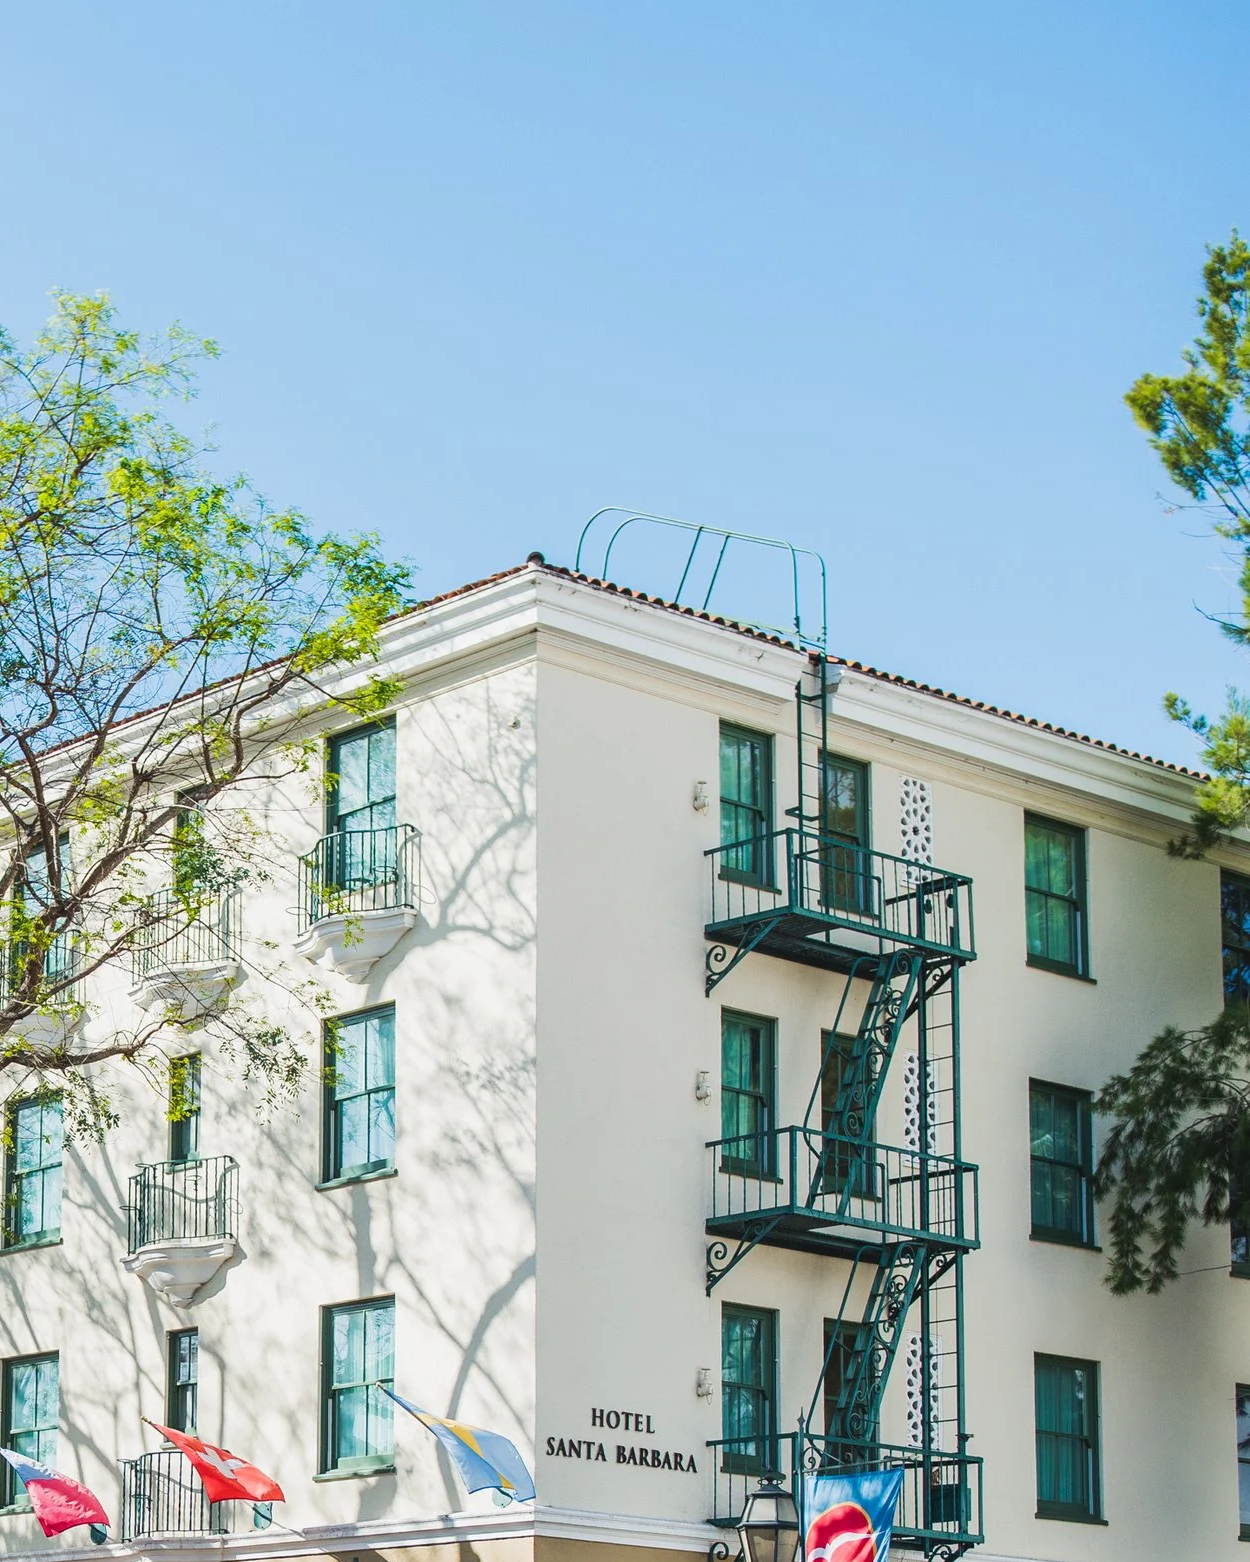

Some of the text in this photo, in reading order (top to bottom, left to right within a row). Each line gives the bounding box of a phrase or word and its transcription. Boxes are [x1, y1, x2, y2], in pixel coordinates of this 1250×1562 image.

[591, 1407, 655, 1434] HOTEL
[546, 1436, 698, 1473] SANTA BARBARA
